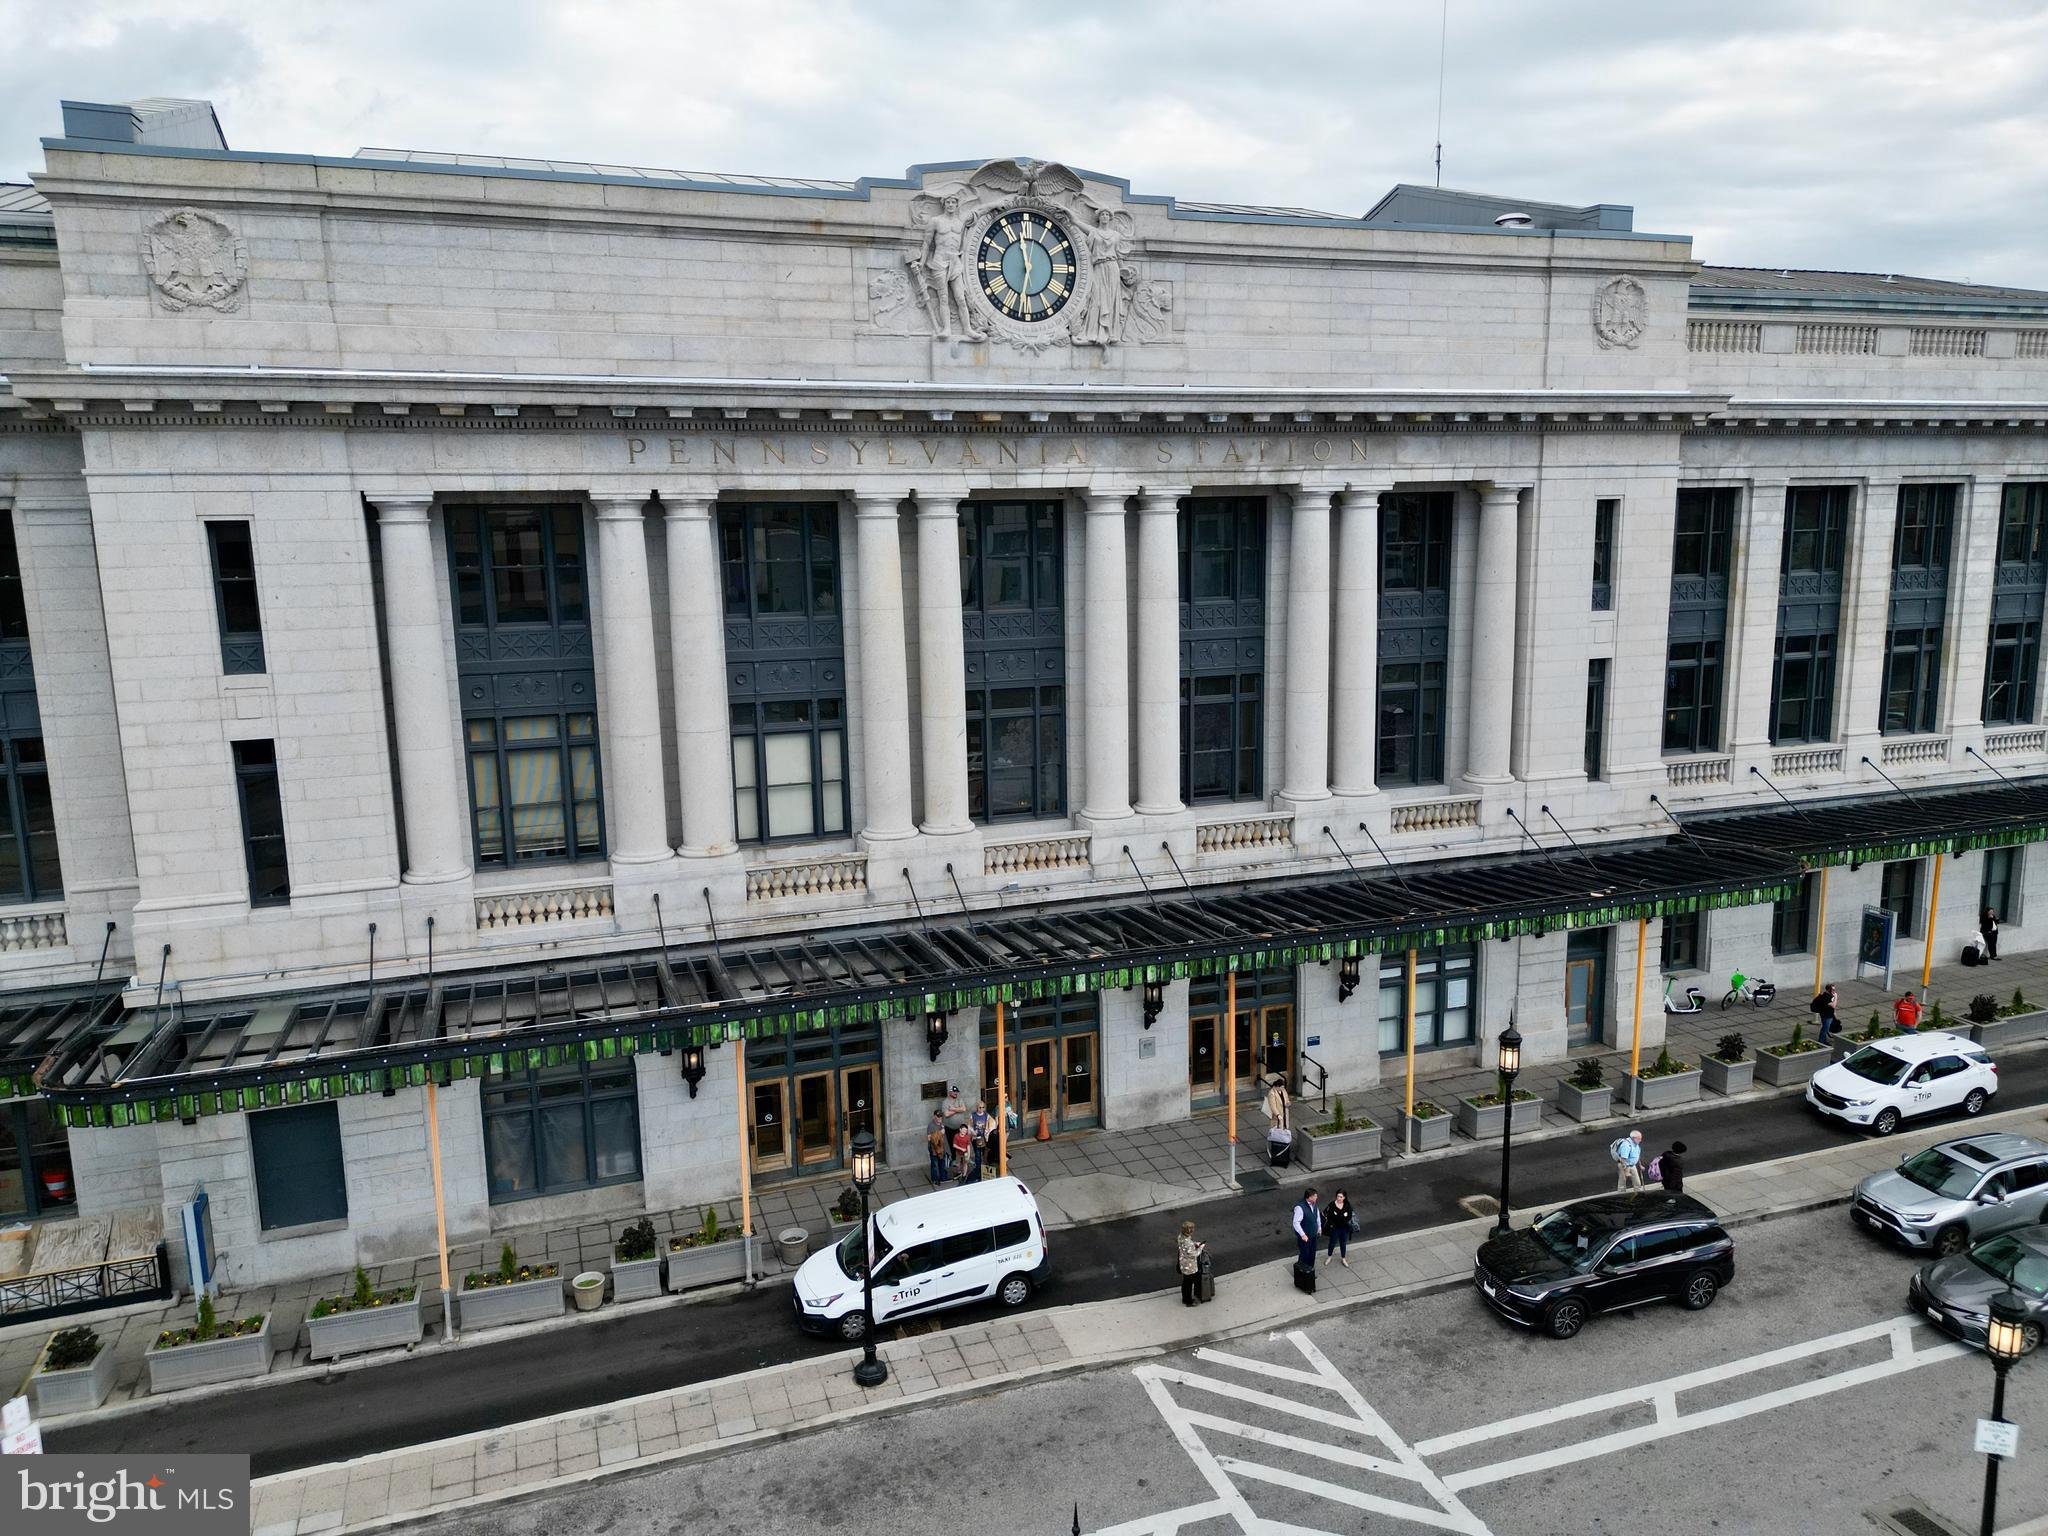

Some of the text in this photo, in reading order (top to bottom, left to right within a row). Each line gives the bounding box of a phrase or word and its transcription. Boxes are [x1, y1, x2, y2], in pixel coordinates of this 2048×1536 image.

[1039, 228, 1048, 243] I
[1048, 243, 1063, 256] II
[1053, 264, 1068, 273] III
[627, 438, 1369, 466] PENNSYLVANIA STATION
[1914, 1092, 1932, 1102] zTrip
[997, 1256, 1011, 1264] TAXI
[892, 1287, 921, 1302] zTrip
